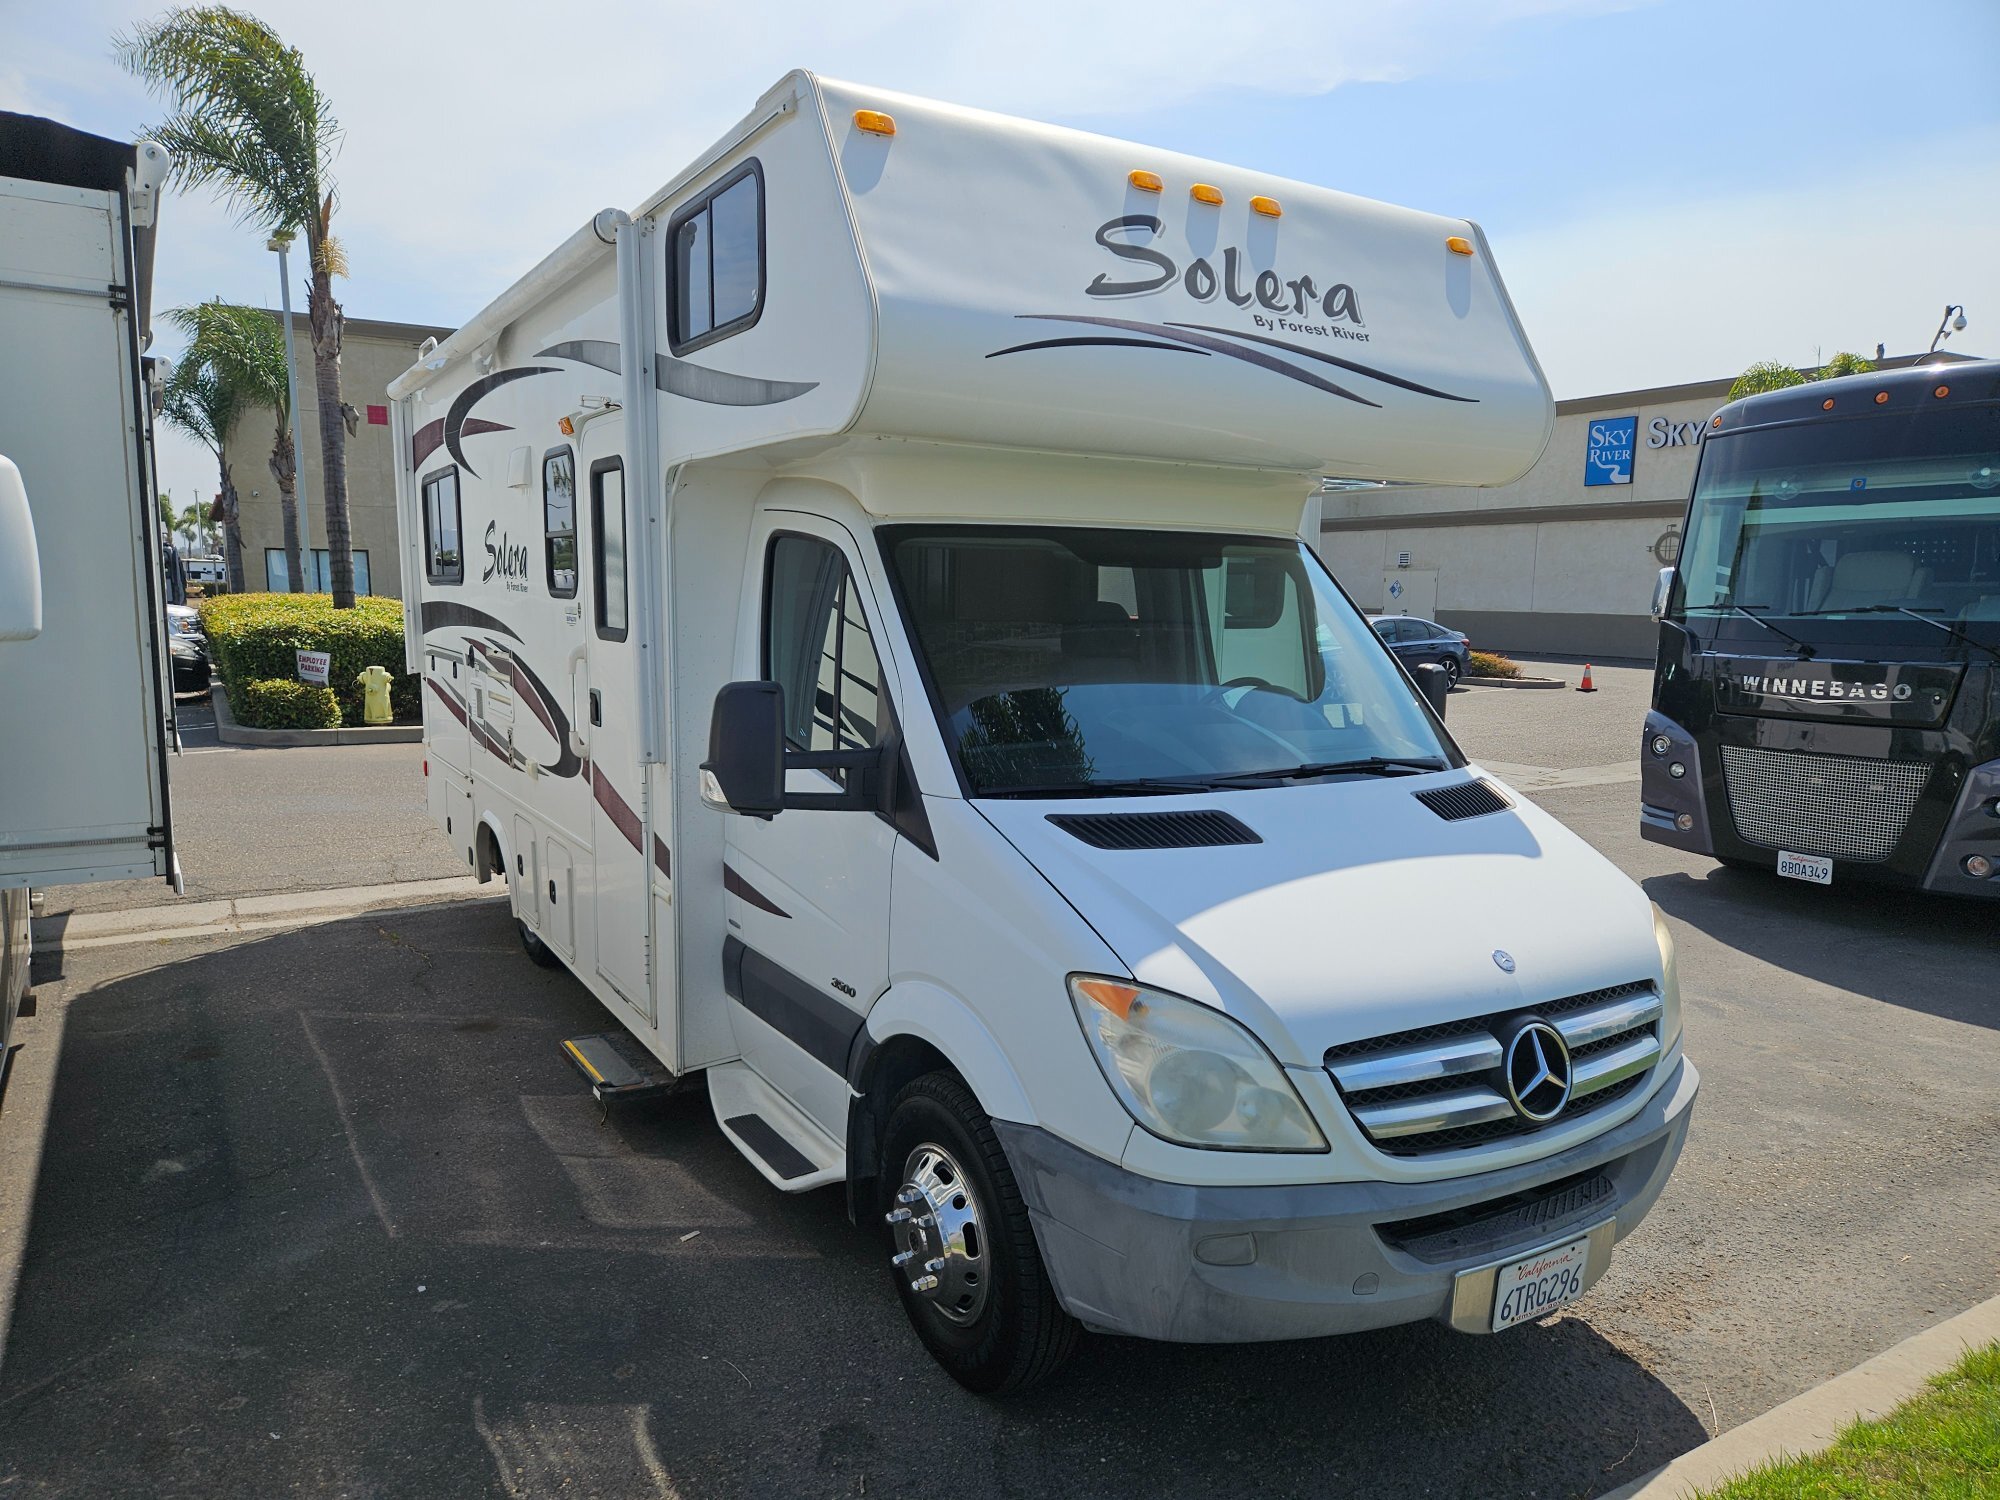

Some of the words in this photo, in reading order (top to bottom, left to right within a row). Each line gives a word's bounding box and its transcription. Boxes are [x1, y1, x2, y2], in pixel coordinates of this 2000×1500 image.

[1085, 214, 1365, 328] Solera
[1253, 314, 1274, 331] By
[1278, 318, 1329, 337] Forest
[1331, 326, 1370, 342] River
[482, 519, 528, 584] Solera
[298, 655, 327, 666] EMPLOYEE
[301, 663, 325, 673] PARKING
[1743, 675, 1912, 700] WINNEBAGO
[831, 977, 857, 998] 3500
[1518, 1252, 1574, 1281] California
[1500, 1263, 1583, 1321] 6TRG296
[1516, 1299, 1564, 1321] dmv.ca.gov
